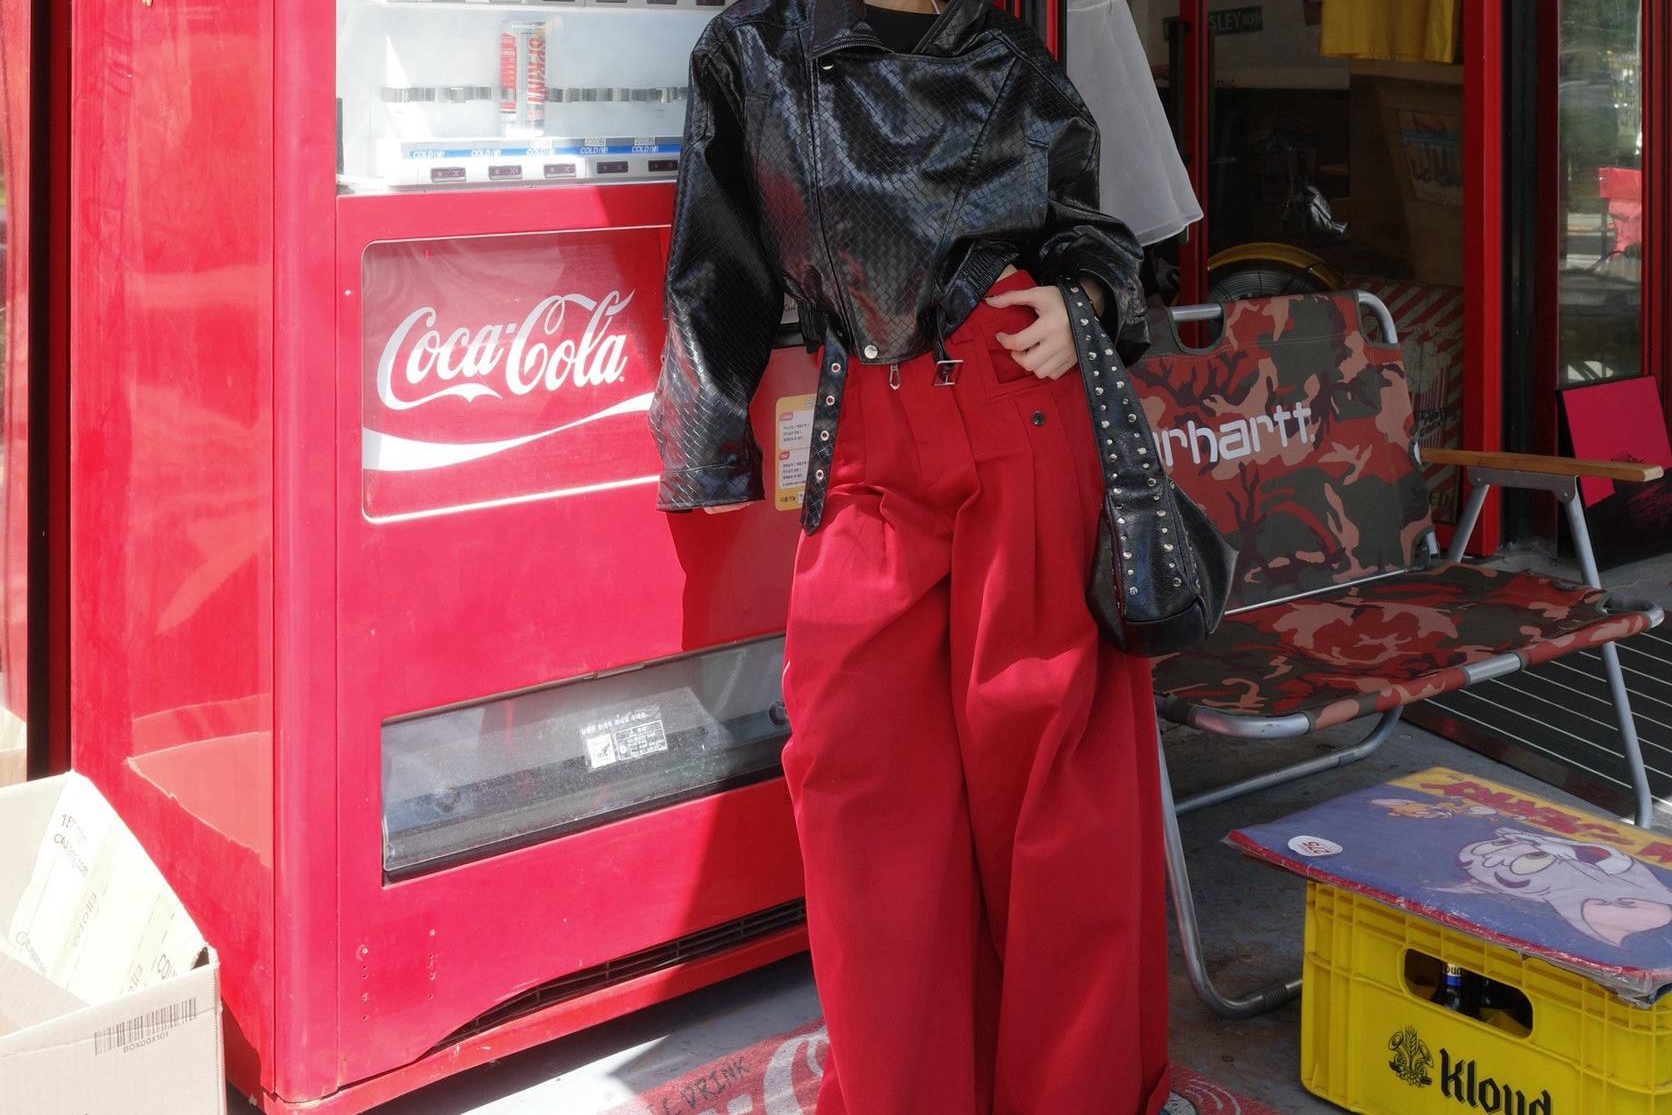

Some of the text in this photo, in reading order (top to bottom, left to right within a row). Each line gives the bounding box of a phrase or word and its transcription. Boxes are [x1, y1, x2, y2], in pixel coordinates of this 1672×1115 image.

[376, 287, 636, 410] Coca-Cola
[680, 1056, 751, 1110] DRINK
[1439, 1047, 1553, 1115] Kloud
